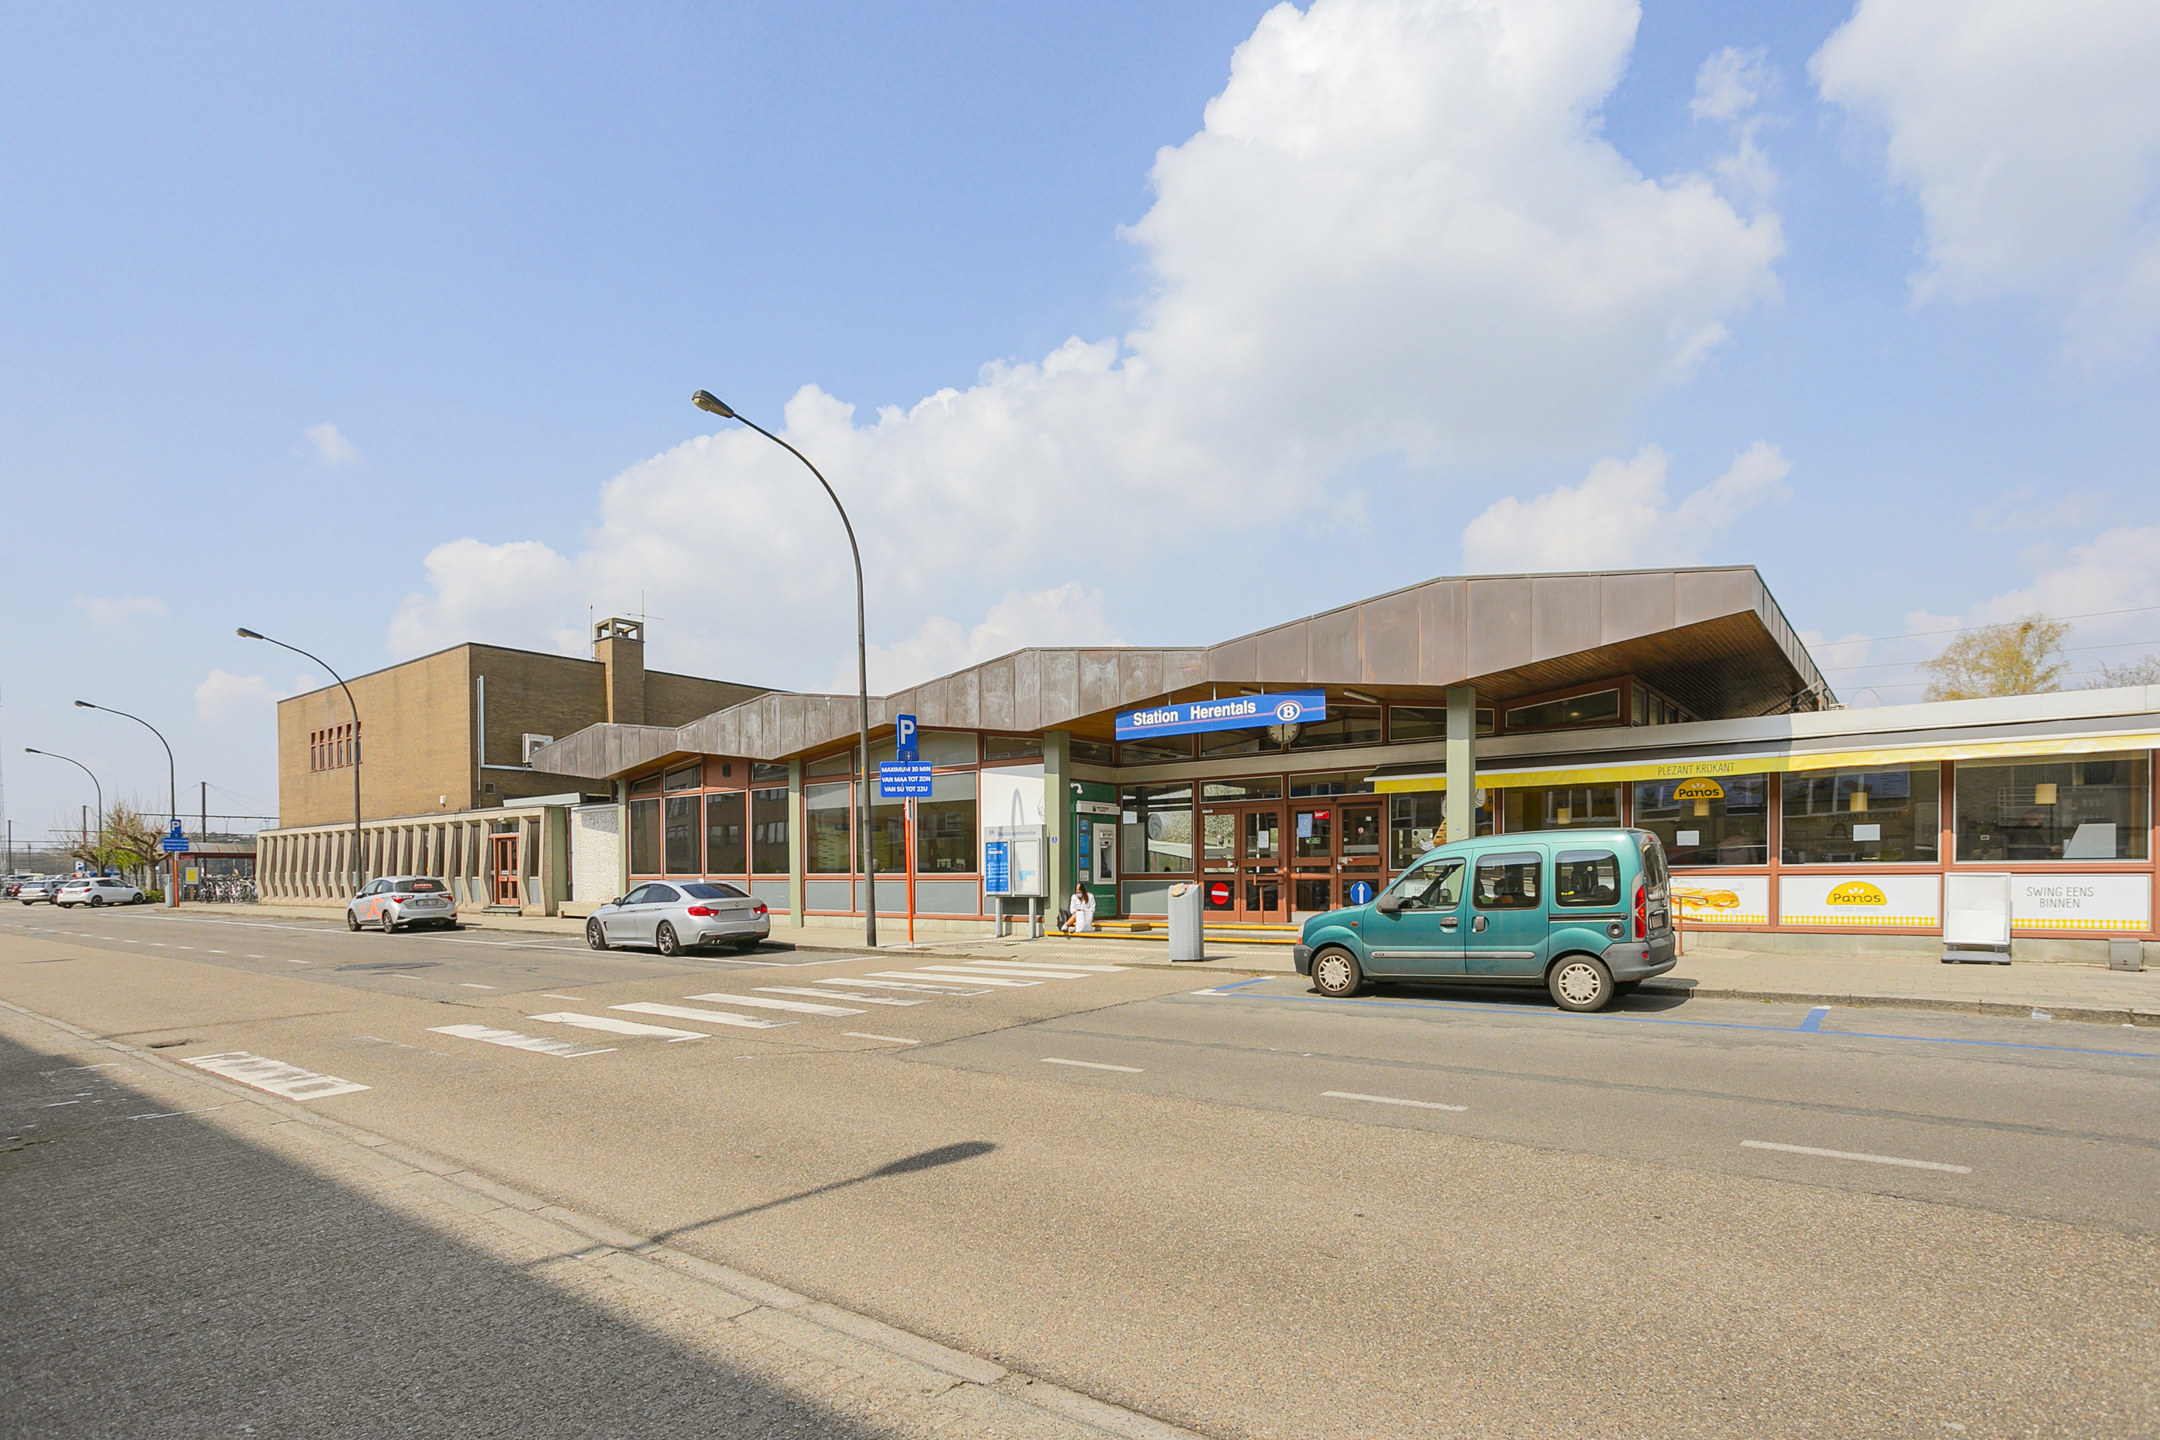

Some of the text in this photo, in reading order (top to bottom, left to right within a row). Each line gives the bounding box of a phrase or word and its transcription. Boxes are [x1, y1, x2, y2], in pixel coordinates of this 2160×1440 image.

[1133, 700, 1256, 726] Station Herentals
[900, 719, 915, 745] P
[1657, 762, 1735, 776] PLEZANT KROKANT
[1678, 788, 1720, 798] Panos
[171, 820, 180, 831] P
[2026, 886, 2094, 897] SWING EENS
[1833, 893, 1881, 903] Panos
[2039, 898, 2080, 908] BINNEN
